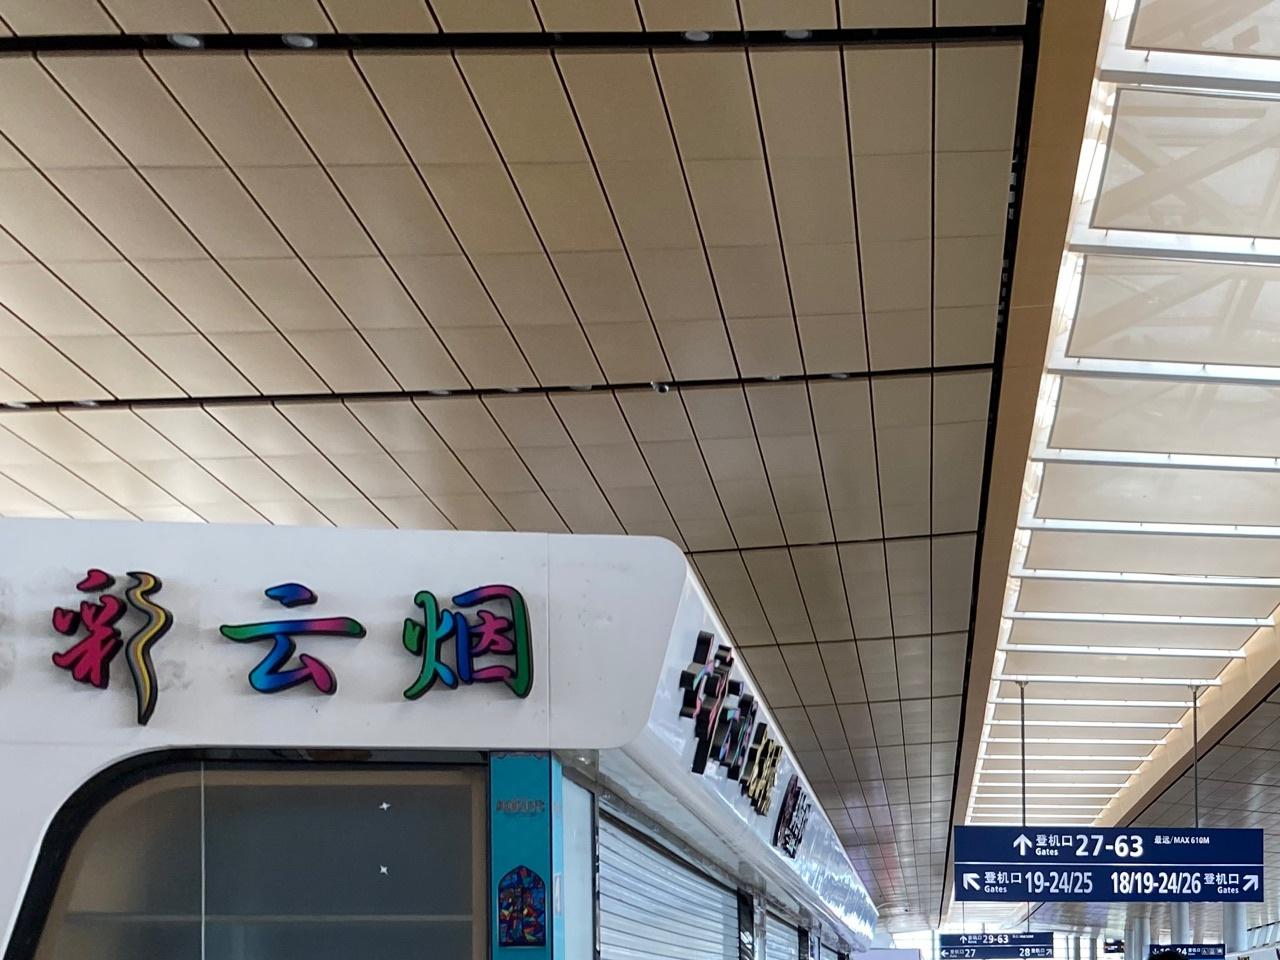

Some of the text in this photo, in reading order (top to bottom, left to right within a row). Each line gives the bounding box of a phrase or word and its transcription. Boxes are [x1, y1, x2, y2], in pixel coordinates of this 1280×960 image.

[1035, 834, 1073, 847] 登机口
[1075, 834, 1144, 857] 27-63
[1035, 847, 1059, 856] Gates
[984, 871, 1239, 894] 登机口 19-24/25 18/19-24/26 登机口
[984, 884, 1008, 893] Gates
[1217, 885, 1240, 895] Gates
[982, 934, 1009, 944] 29-63
[964, 949, 976, 958] 27
[1019, 948, 1031, 957] 28
